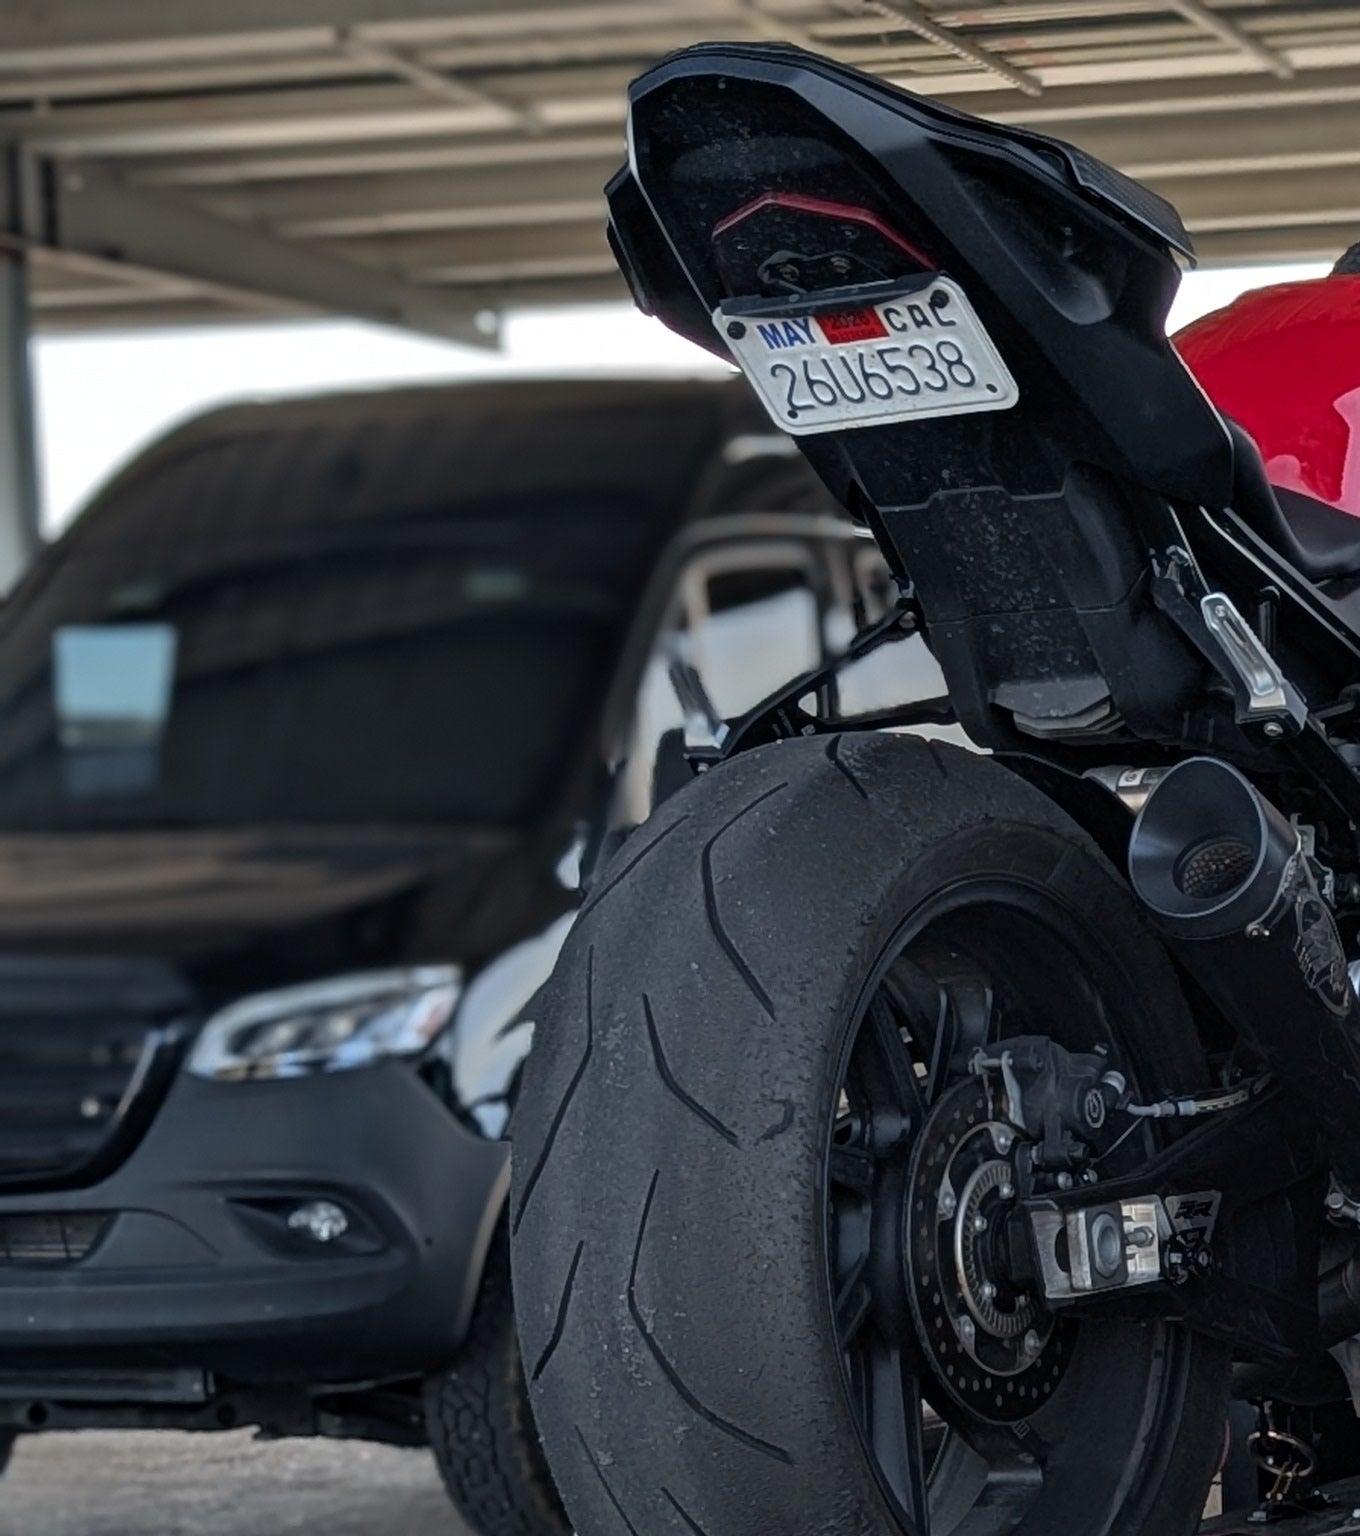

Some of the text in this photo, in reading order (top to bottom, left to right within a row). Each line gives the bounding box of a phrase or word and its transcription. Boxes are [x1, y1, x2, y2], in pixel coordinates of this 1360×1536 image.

[757, 318, 816, 349] MAY
[883, 303, 957, 332] CAL
[770, 340, 976, 411] 26U6538
